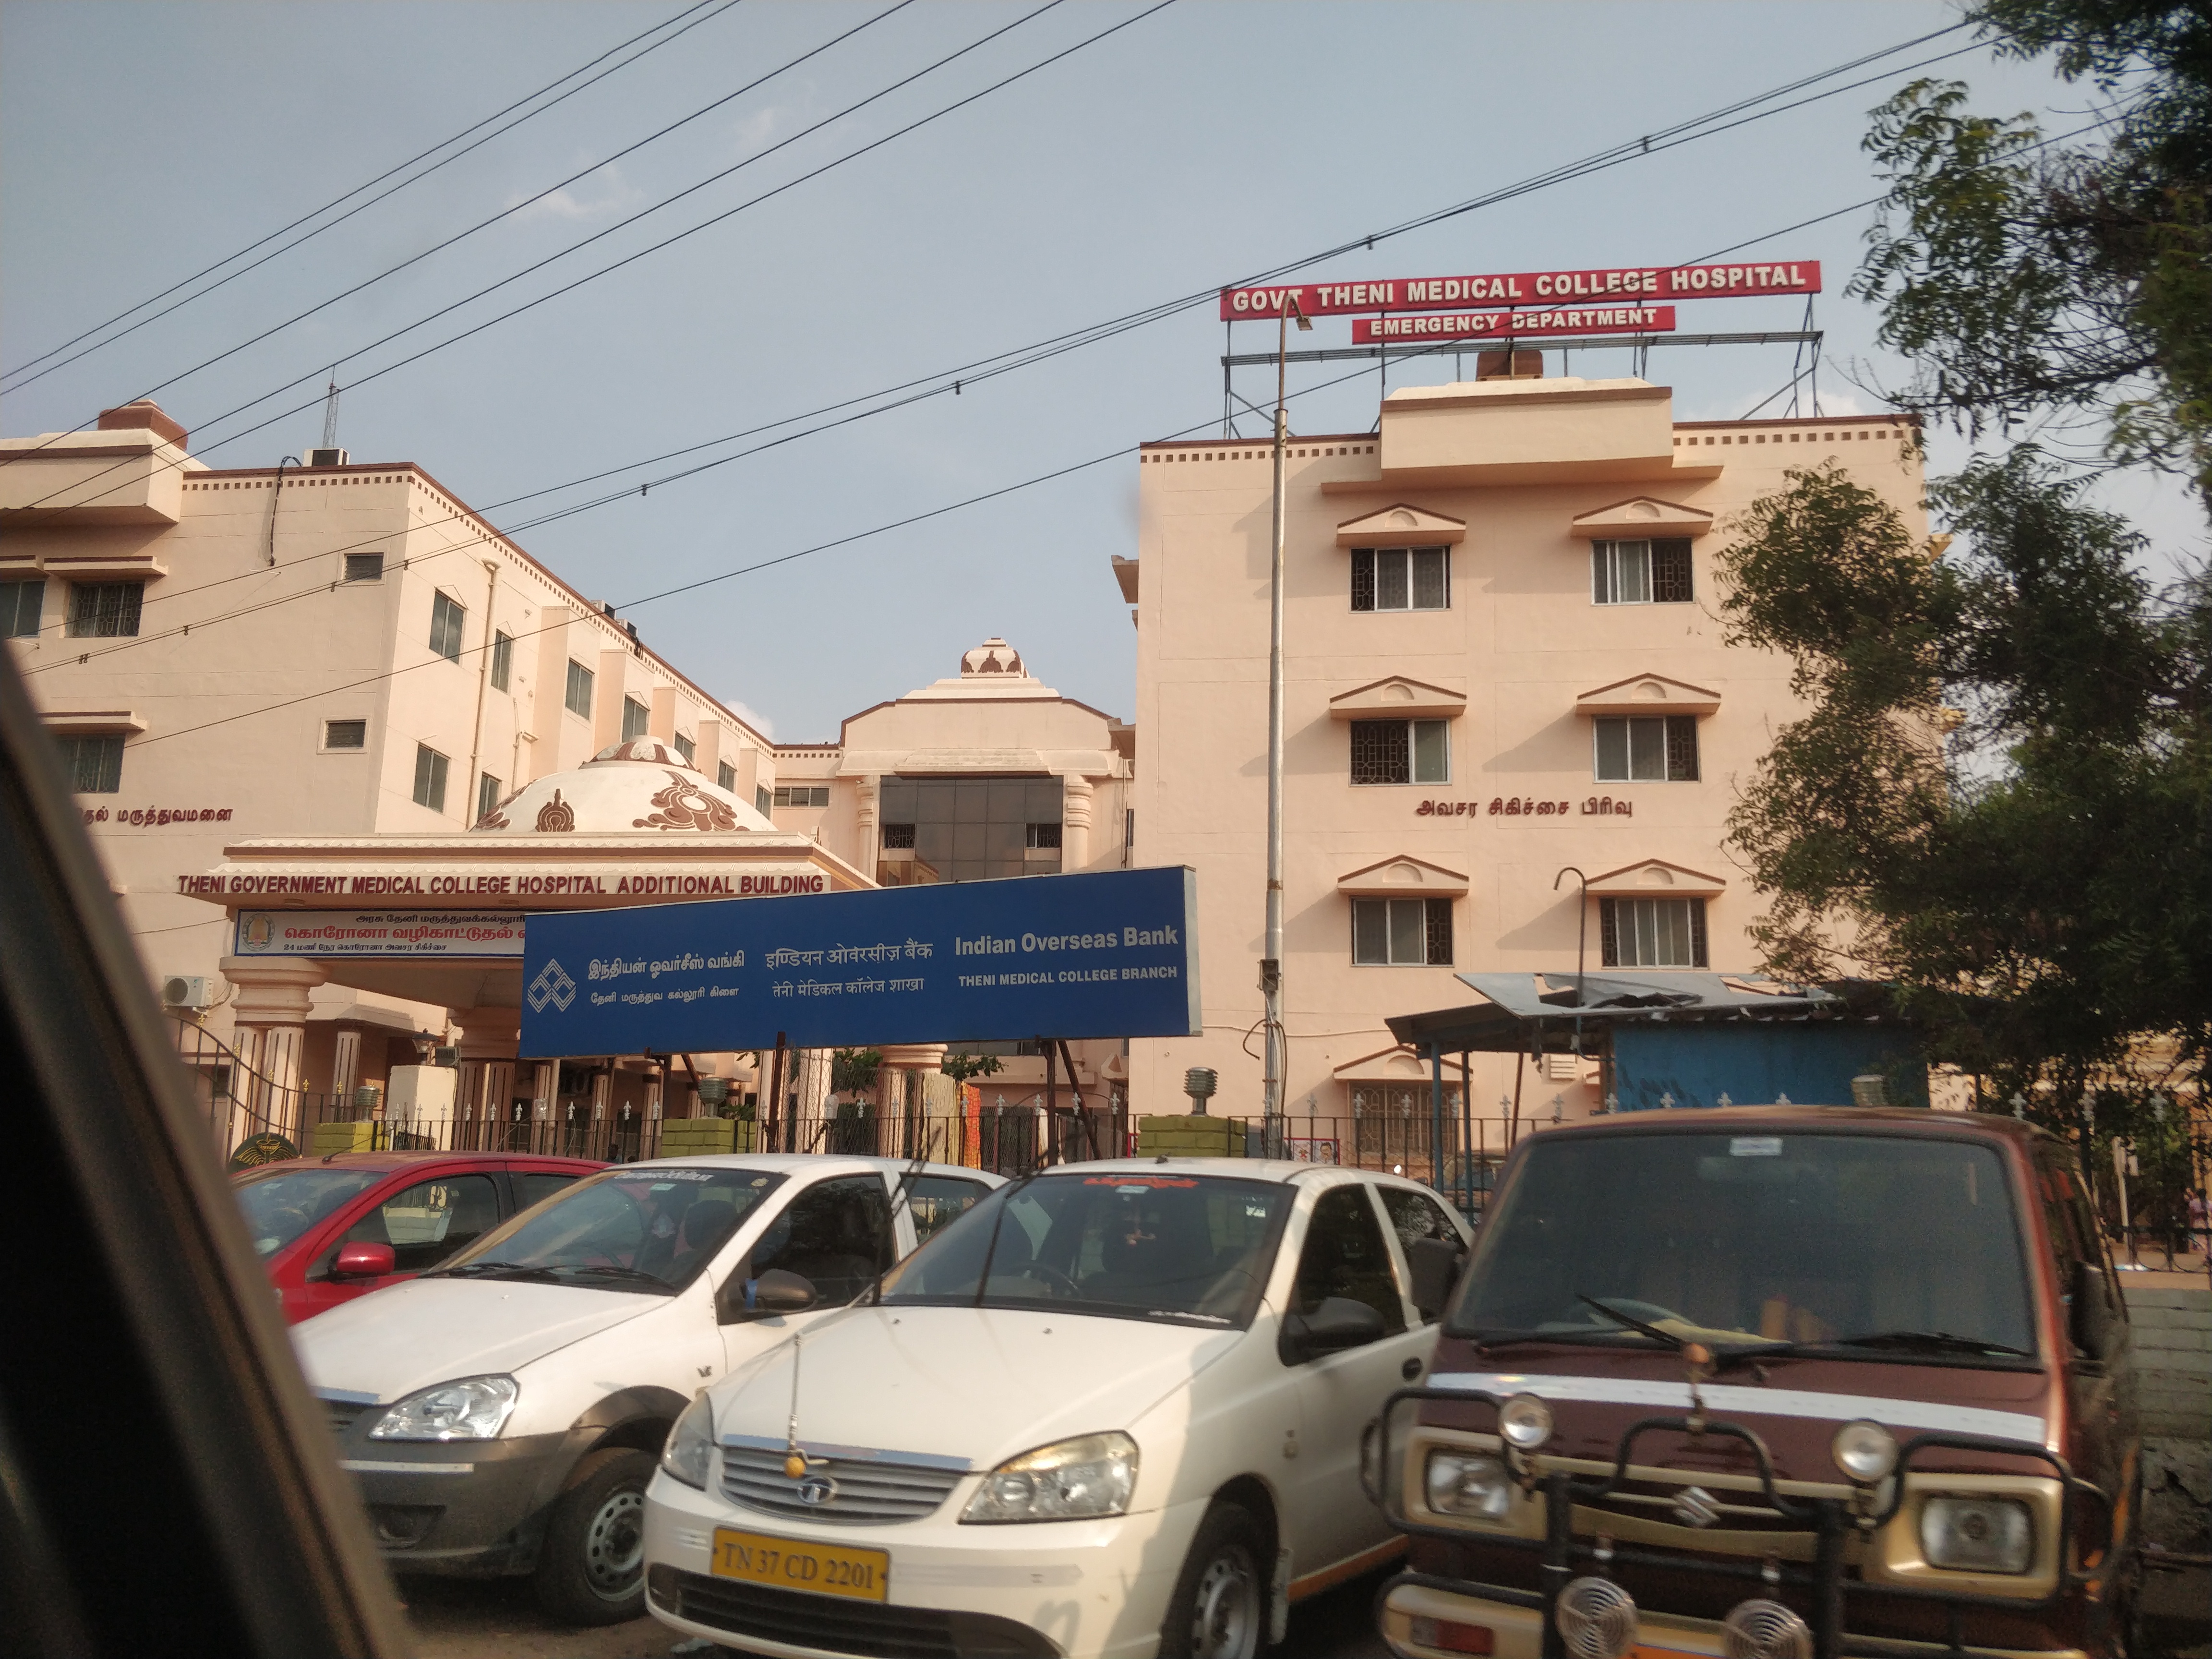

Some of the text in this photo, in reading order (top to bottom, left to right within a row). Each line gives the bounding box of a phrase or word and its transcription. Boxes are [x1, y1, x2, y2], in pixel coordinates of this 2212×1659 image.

[1317, 283, 1393, 308] THENI
[1407, 277, 1522, 302] MEDICAL
[1536, 271, 1658, 296] COLLEGE
[1671, 265, 1806, 291] HOSPITAL
[1370, 308, 1657, 336] EMERGENCY DEPARTMENT
[117, 805, 233, 829] மருத்துவமனை
[1415, 796, 1633, 819] அவசர சிகிச்சை பிரிவு
[179, 875, 824, 893] THENI GOVERNMENT MEDICAL COLLEGE HOSPITAL ADDITIONAL BUILDING
[356, 915, 384, 924] அரசு
[386, 914, 418, 924] தேனி
[285, 926, 388, 939] கொரோனா
[393, 926, 514, 942] வழிகாட்டுதல்
[955, 925, 1178, 955] Indian Overseas Bank
[588, 950, 745, 981] இந்தியன் ஓவர்சீஸ் வங்கி
[765, 948, 824, 971] इण्डियन
[903, 938, 934, 960] बैंक
[772, 976, 925, 998] तेनी मेडिकल कॉलेज शाखा
[959, 966, 1177, 987] THENI MEDICAL COLLEGE BRANCH
[590, 986, 739, 1006] தேனி மருத்துவ கல்லூரி கிளை
[723, 1542, 873, 1589] TN 37 CD 2201
